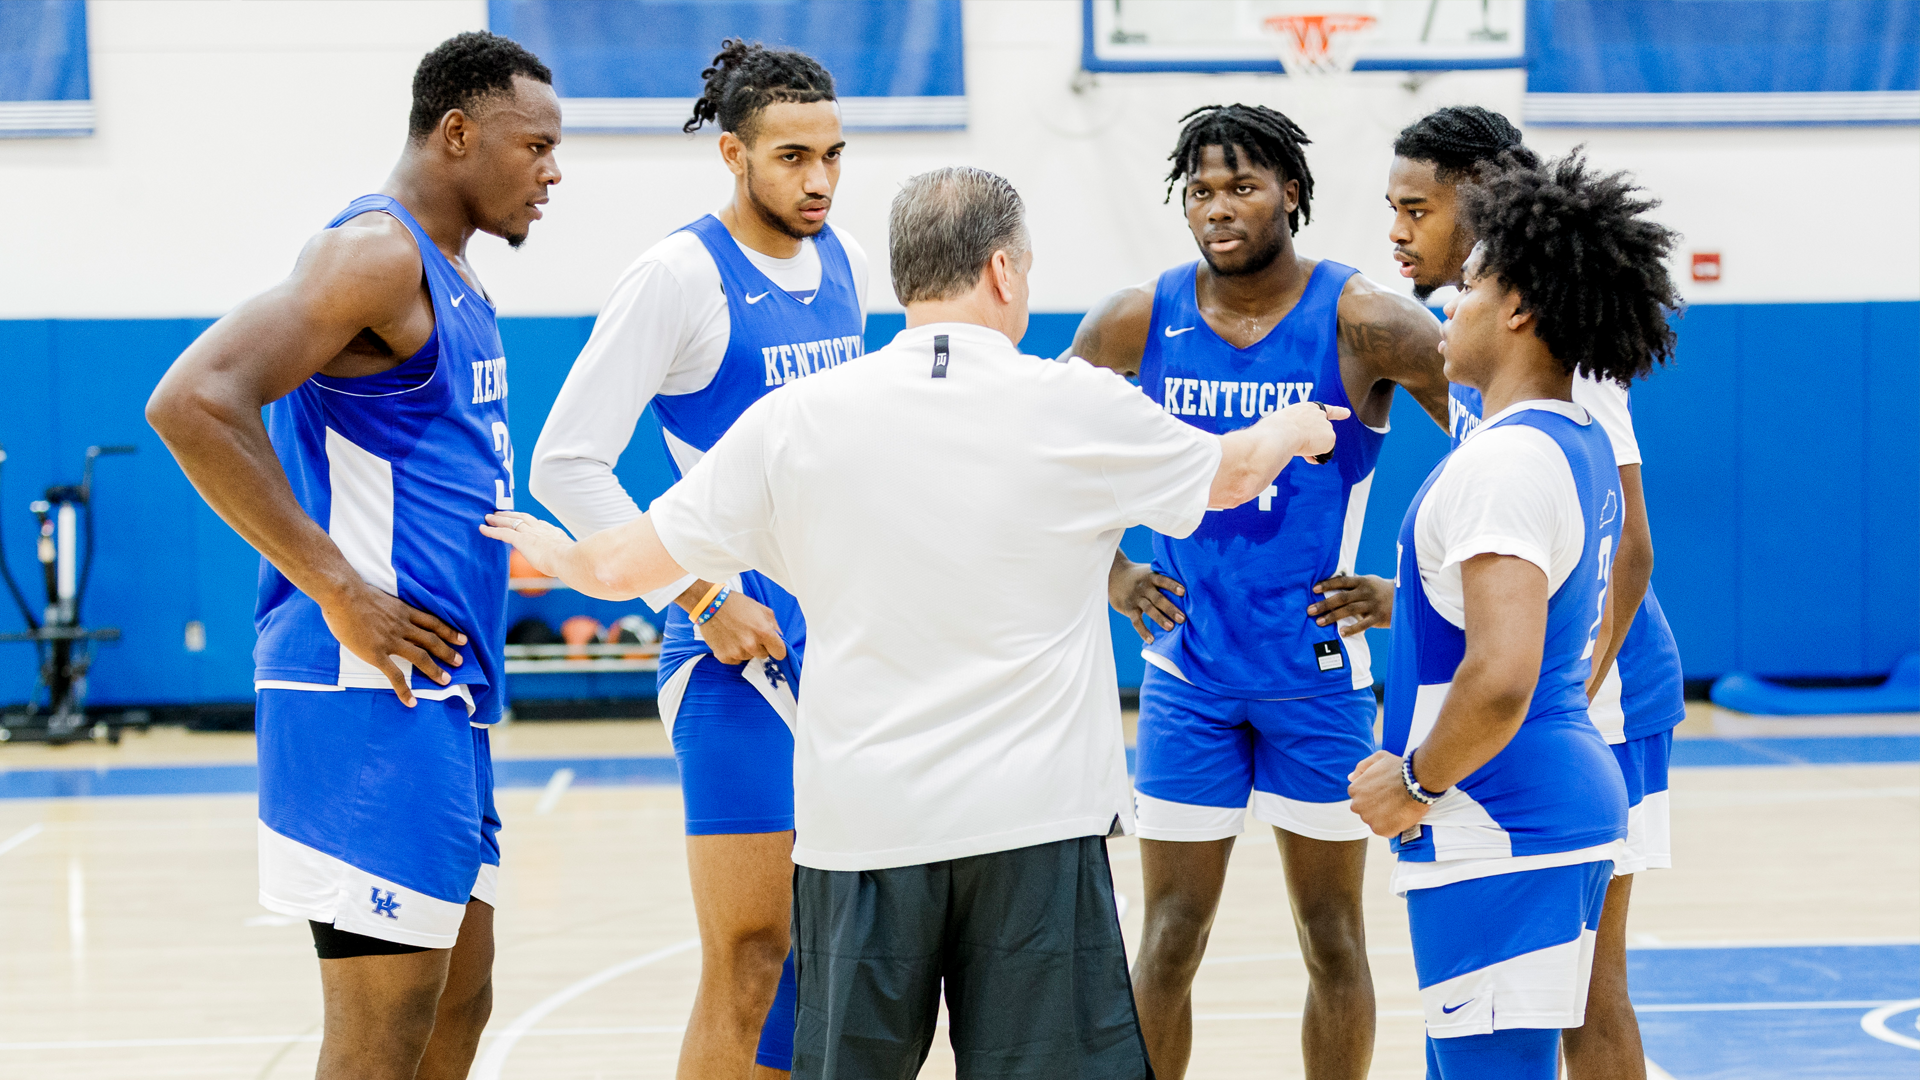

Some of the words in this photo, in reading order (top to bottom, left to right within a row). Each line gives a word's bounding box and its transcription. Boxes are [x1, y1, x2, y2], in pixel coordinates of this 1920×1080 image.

[1164, 377, 1314, 418] KENTUCKY
[491, 421, 515, 511] 3
[1324, 643, 1332, 654] L
[369, 885, 403, 921] UK
